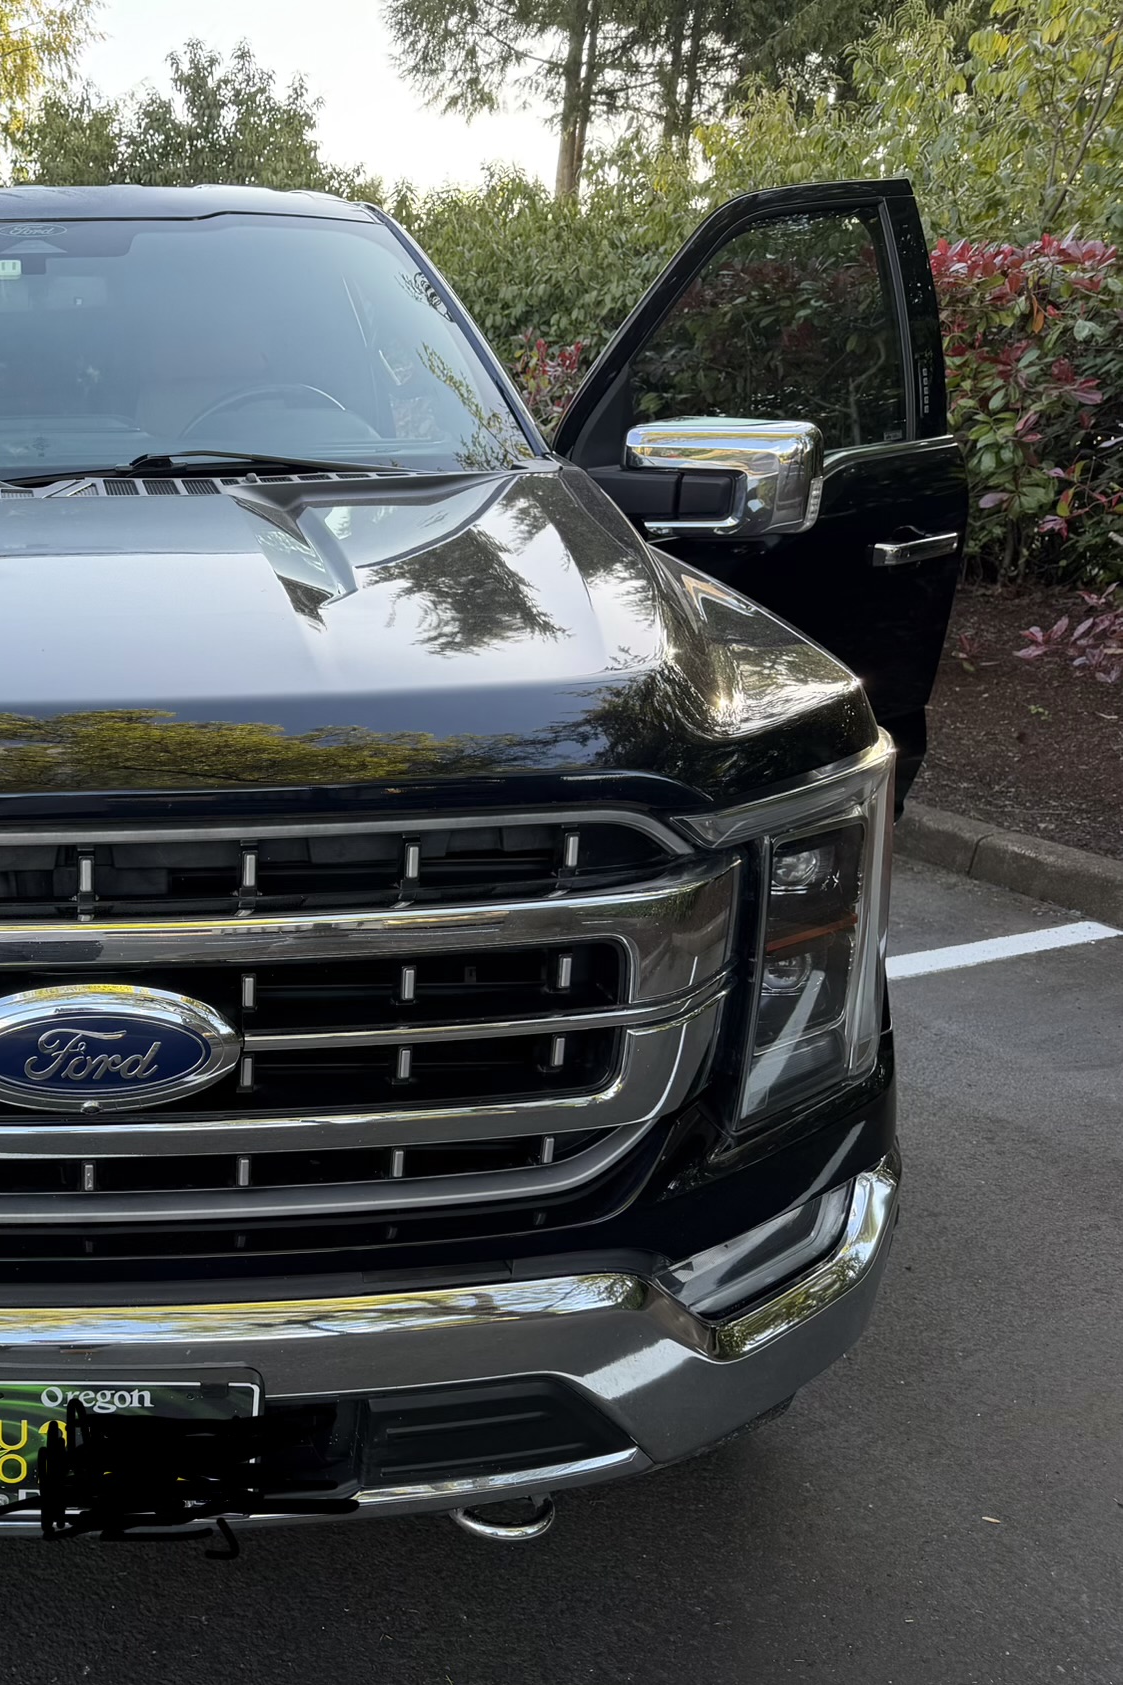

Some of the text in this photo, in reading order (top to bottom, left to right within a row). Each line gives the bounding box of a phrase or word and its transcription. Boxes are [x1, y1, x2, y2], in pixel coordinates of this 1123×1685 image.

[9, 225, 55, 236] Ford
[24, 1028, 162, 1081] Ford
[41, 1386, 155, 1413] Oregon
